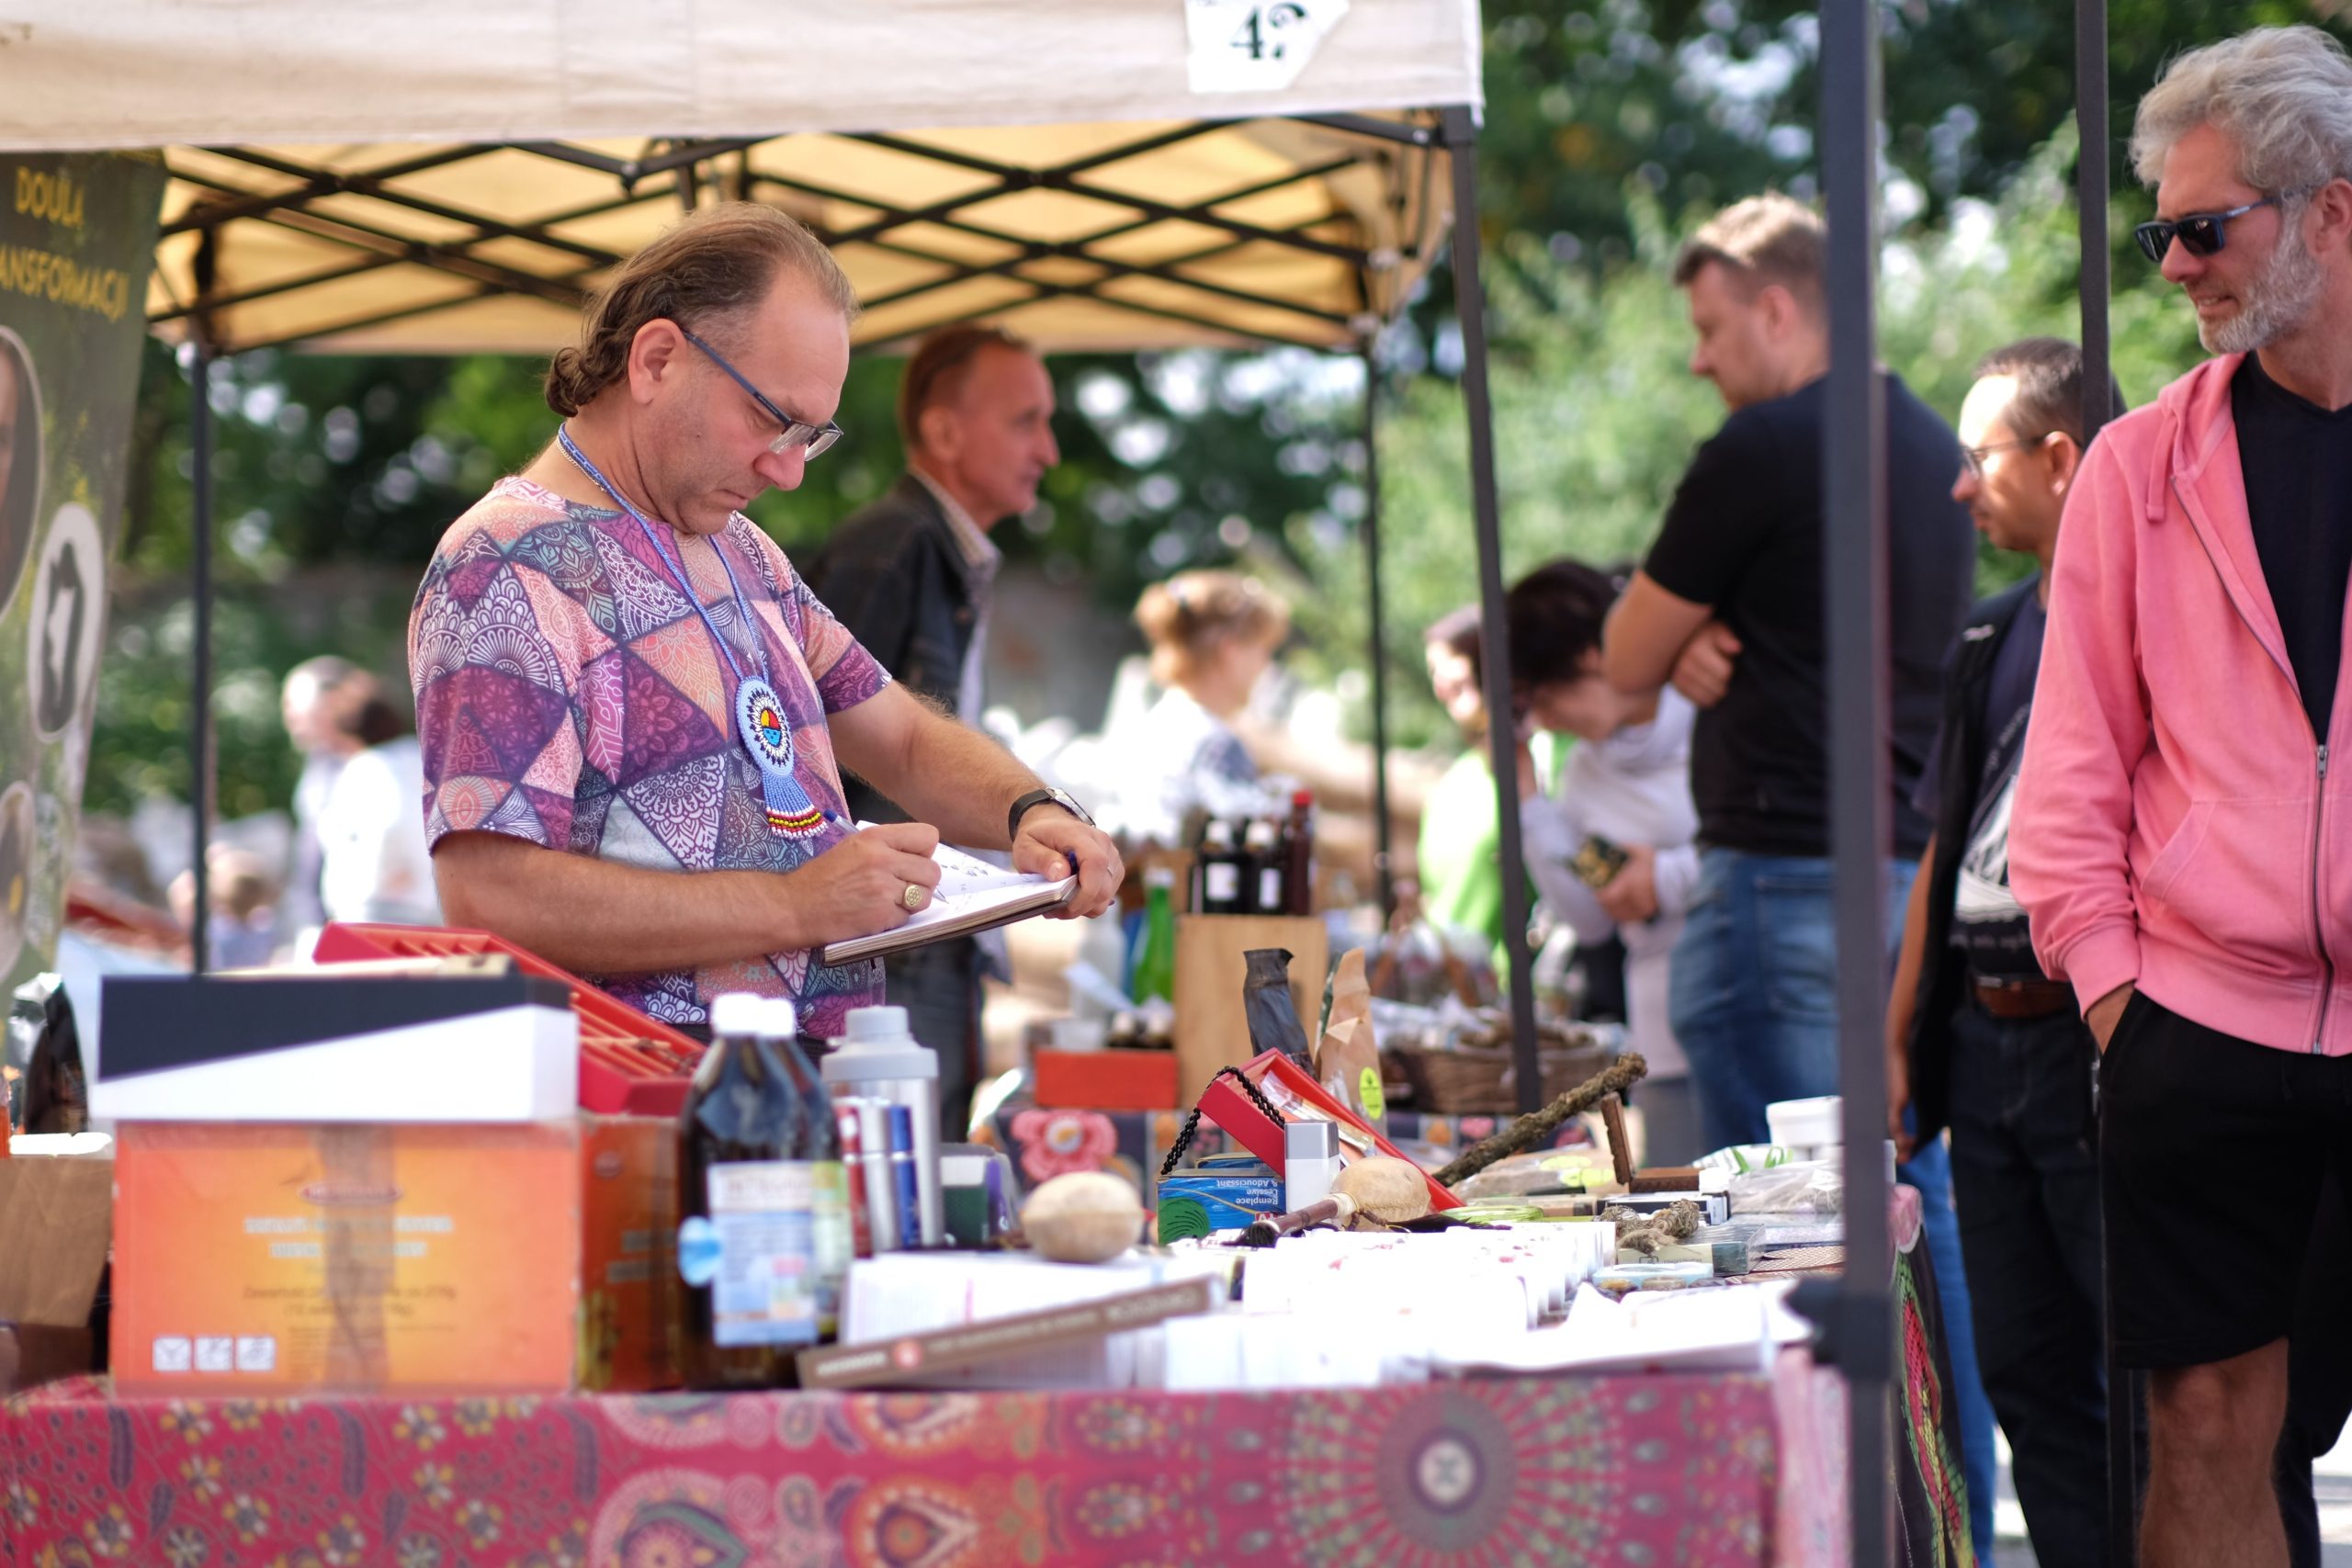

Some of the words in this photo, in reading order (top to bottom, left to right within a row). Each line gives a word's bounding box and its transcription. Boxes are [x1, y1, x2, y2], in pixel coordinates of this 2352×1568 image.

[1216, 1179, 1268, 1188] Adoucissant
[1271, 1179, 1278, 1188] &
[1247, 1189, 1278, 1197] Lessive
[1236, 1197, 1278, 1205] Remplace
